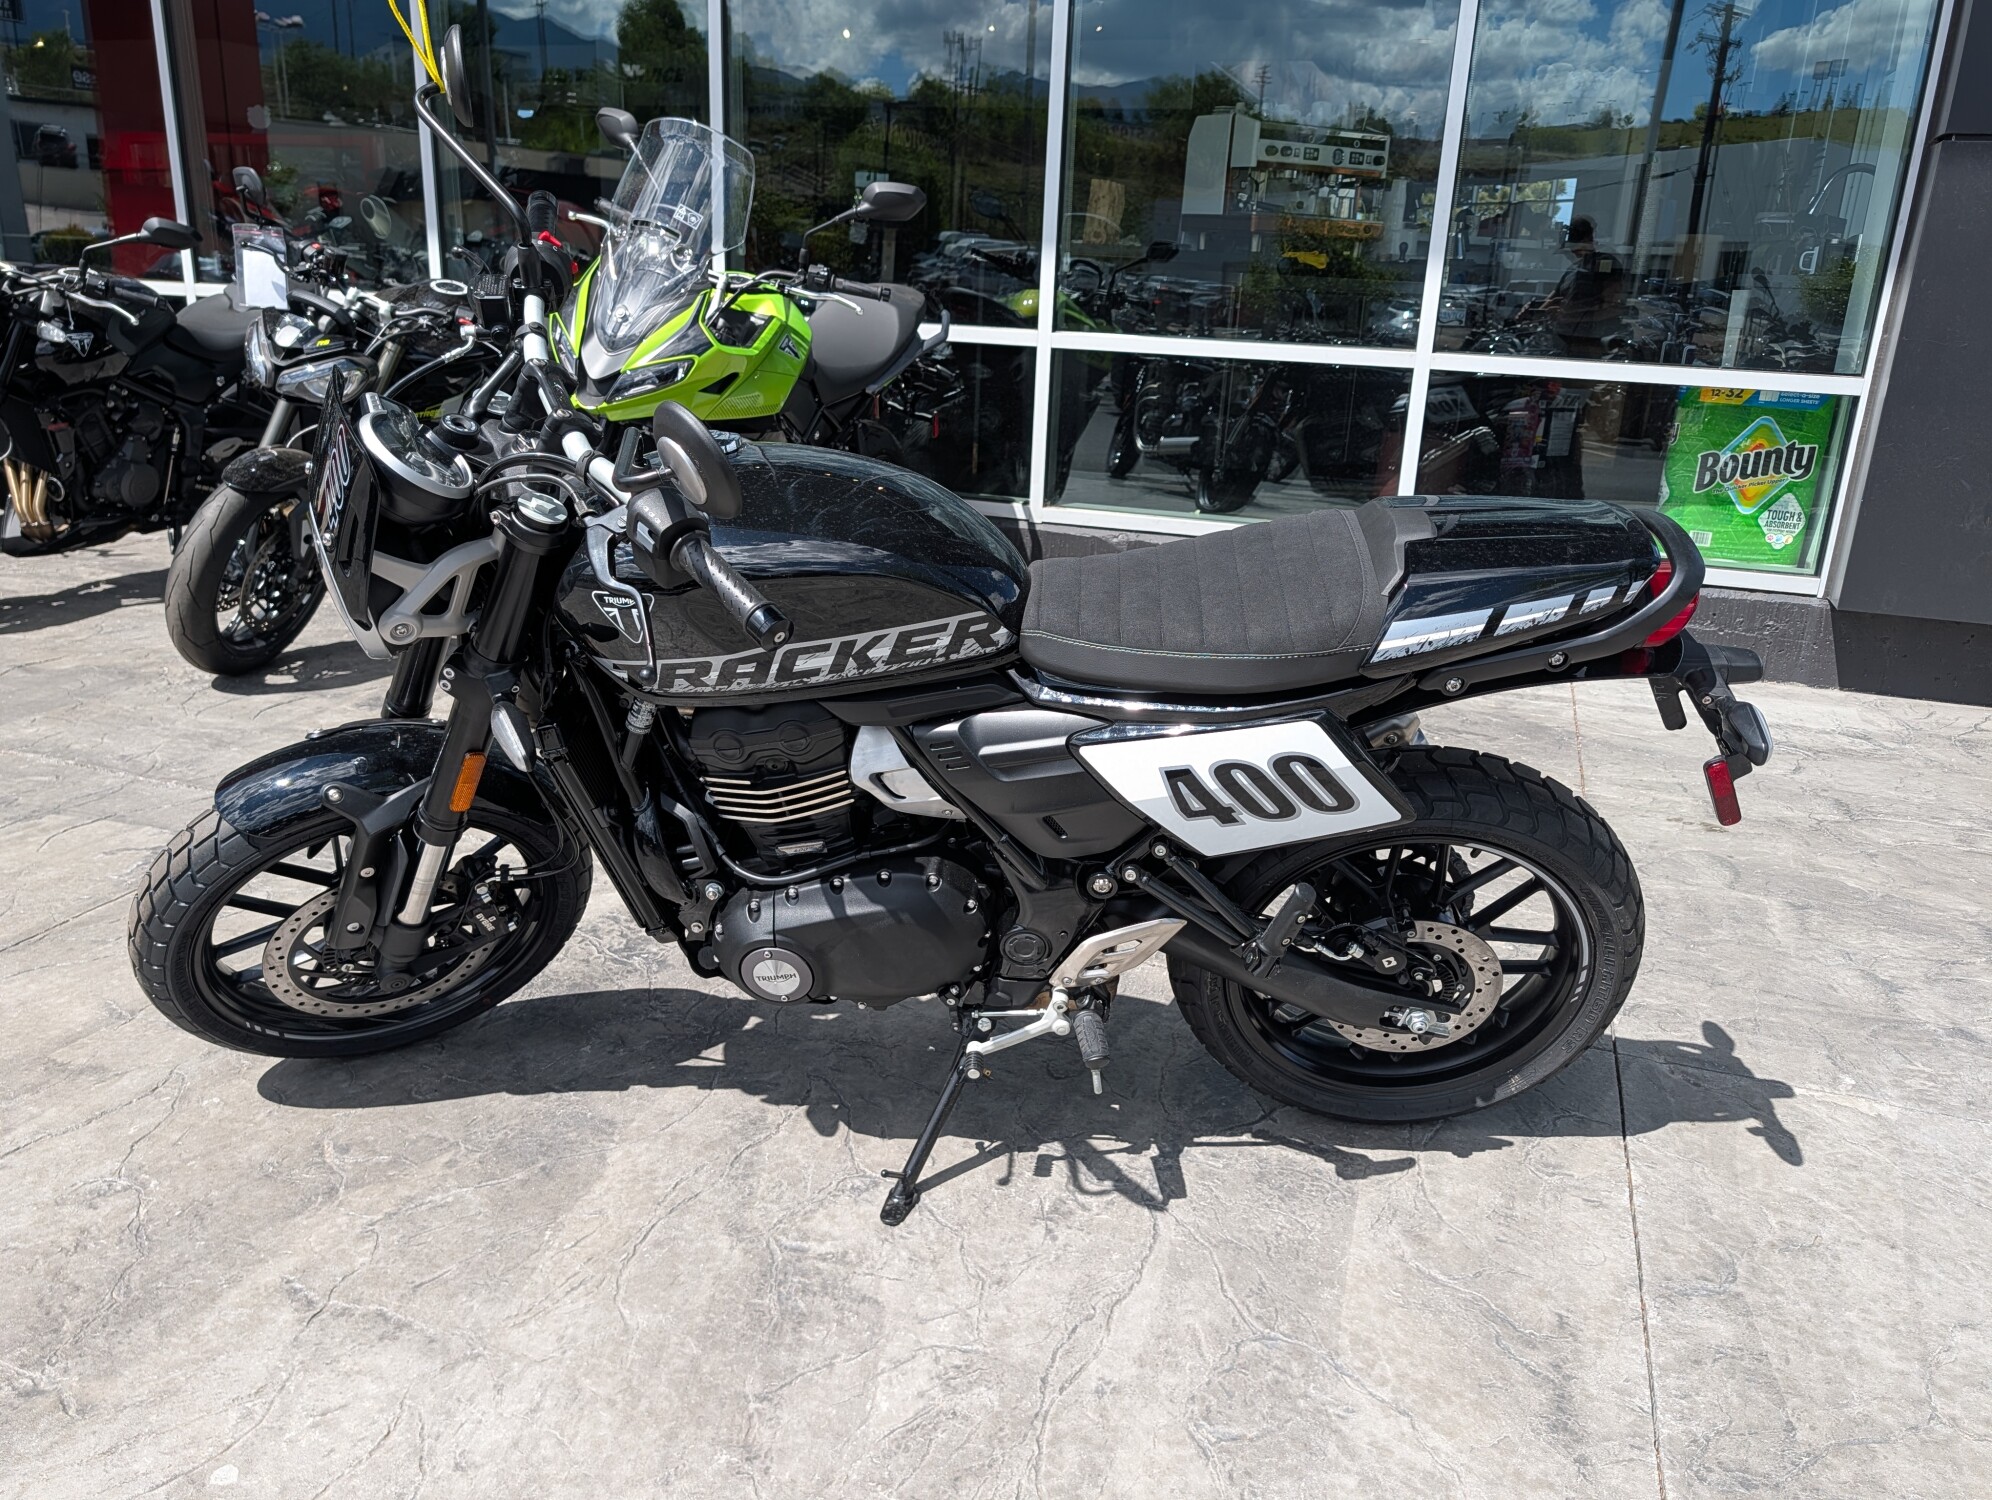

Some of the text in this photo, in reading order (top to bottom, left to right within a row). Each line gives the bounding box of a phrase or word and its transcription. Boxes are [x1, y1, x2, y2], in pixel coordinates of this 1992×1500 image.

[1693, 439, 1818, 493] Bounty
[1767, 509, 1803, 522] TOUGH &
[1763, 520, 1801, 530] ABSORBENT
[1158, 751, 1361, 828] 400
[755, 972, 797, 983] TRIUMPH
